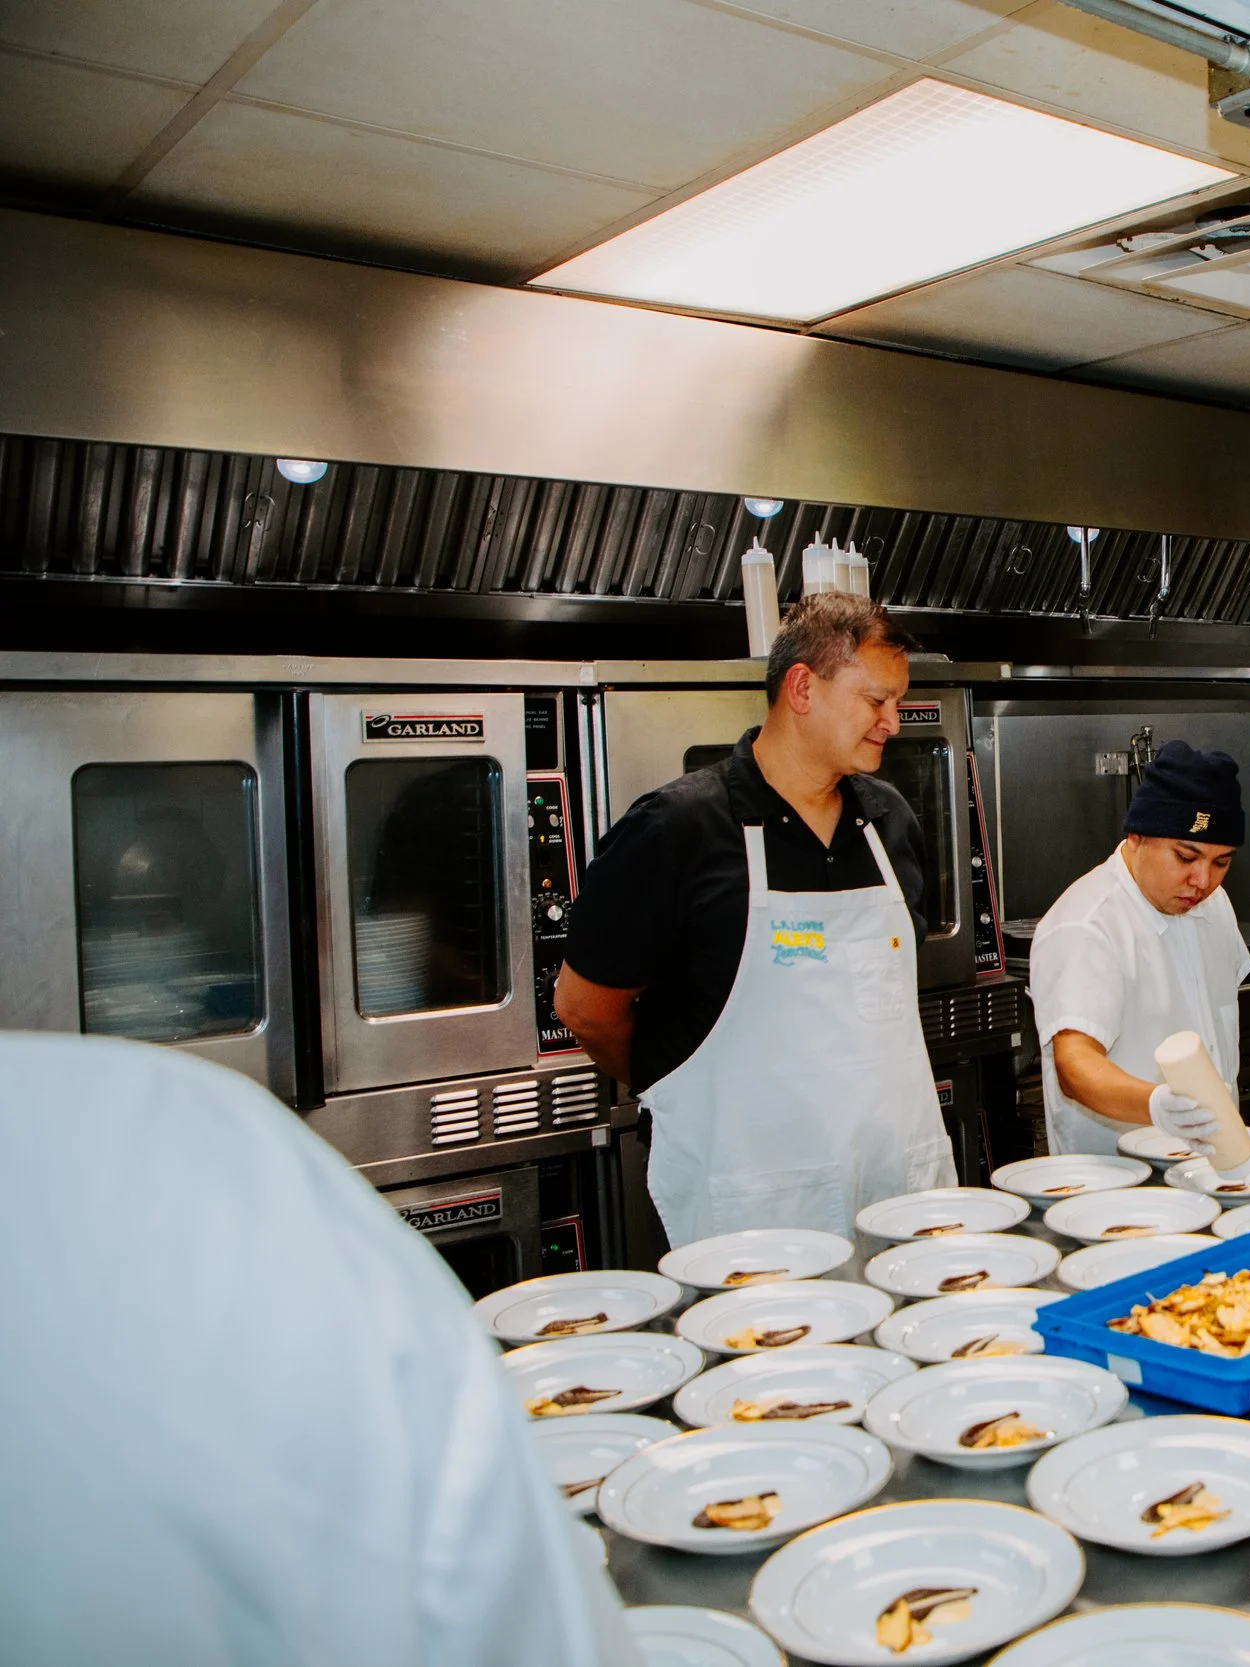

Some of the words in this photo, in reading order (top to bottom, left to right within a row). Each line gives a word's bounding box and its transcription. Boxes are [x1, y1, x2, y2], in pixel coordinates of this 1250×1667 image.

[898, 712, 937, 721] RLAND
[387, 723, 480, 736] GARLAND
[407, 1202, 496, 1229] GARLAND
